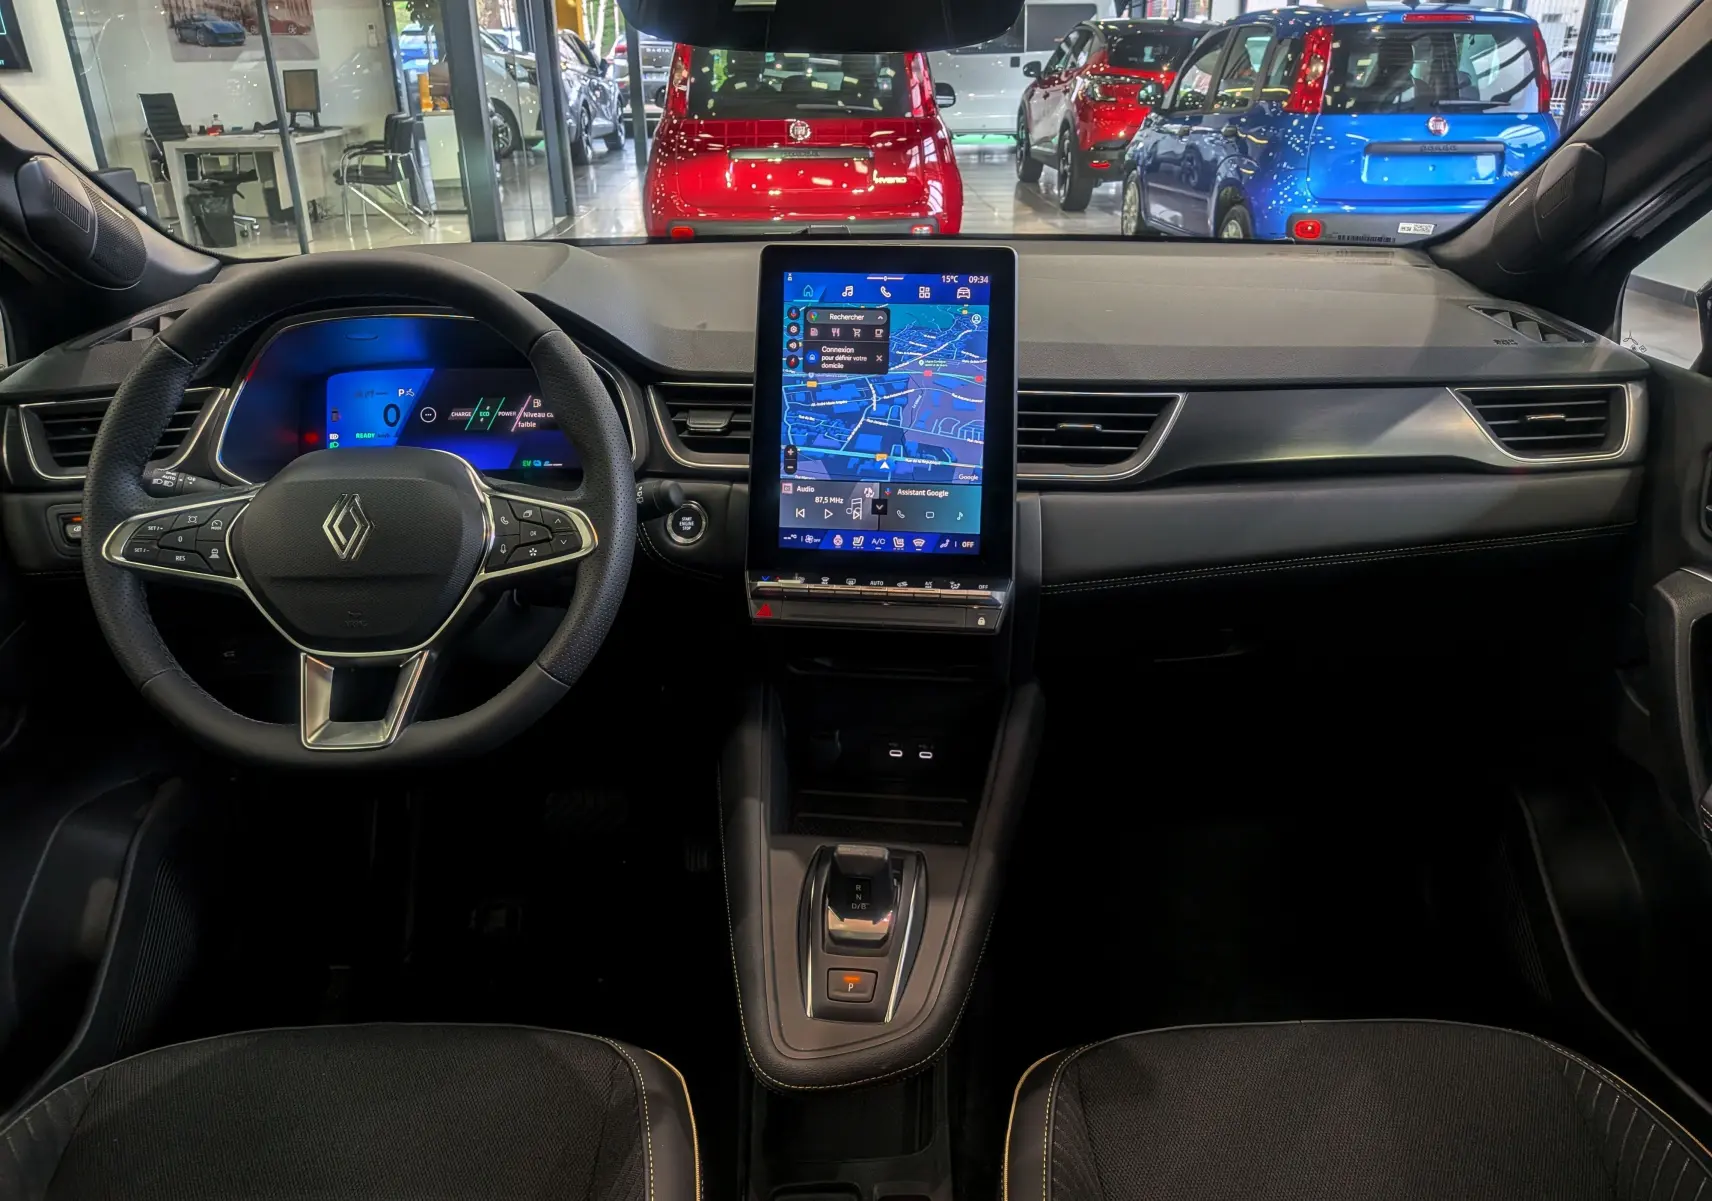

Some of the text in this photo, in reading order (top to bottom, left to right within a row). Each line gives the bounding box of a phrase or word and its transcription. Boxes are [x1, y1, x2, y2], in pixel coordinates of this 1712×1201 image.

[968, 275, 989, 284] 09:34
[829, 313, 864, 321] Rechercher
[821, 345, 855, 353] Connexion
[383, 403, 401, 428] 0
[958, 473, 979, 481] Google
[796, 485, 815, 493] Audio
[926, 490, 949, 498] Google
[814, 496, 829, 504] 87,5
[848, 983, 854, 992] P
